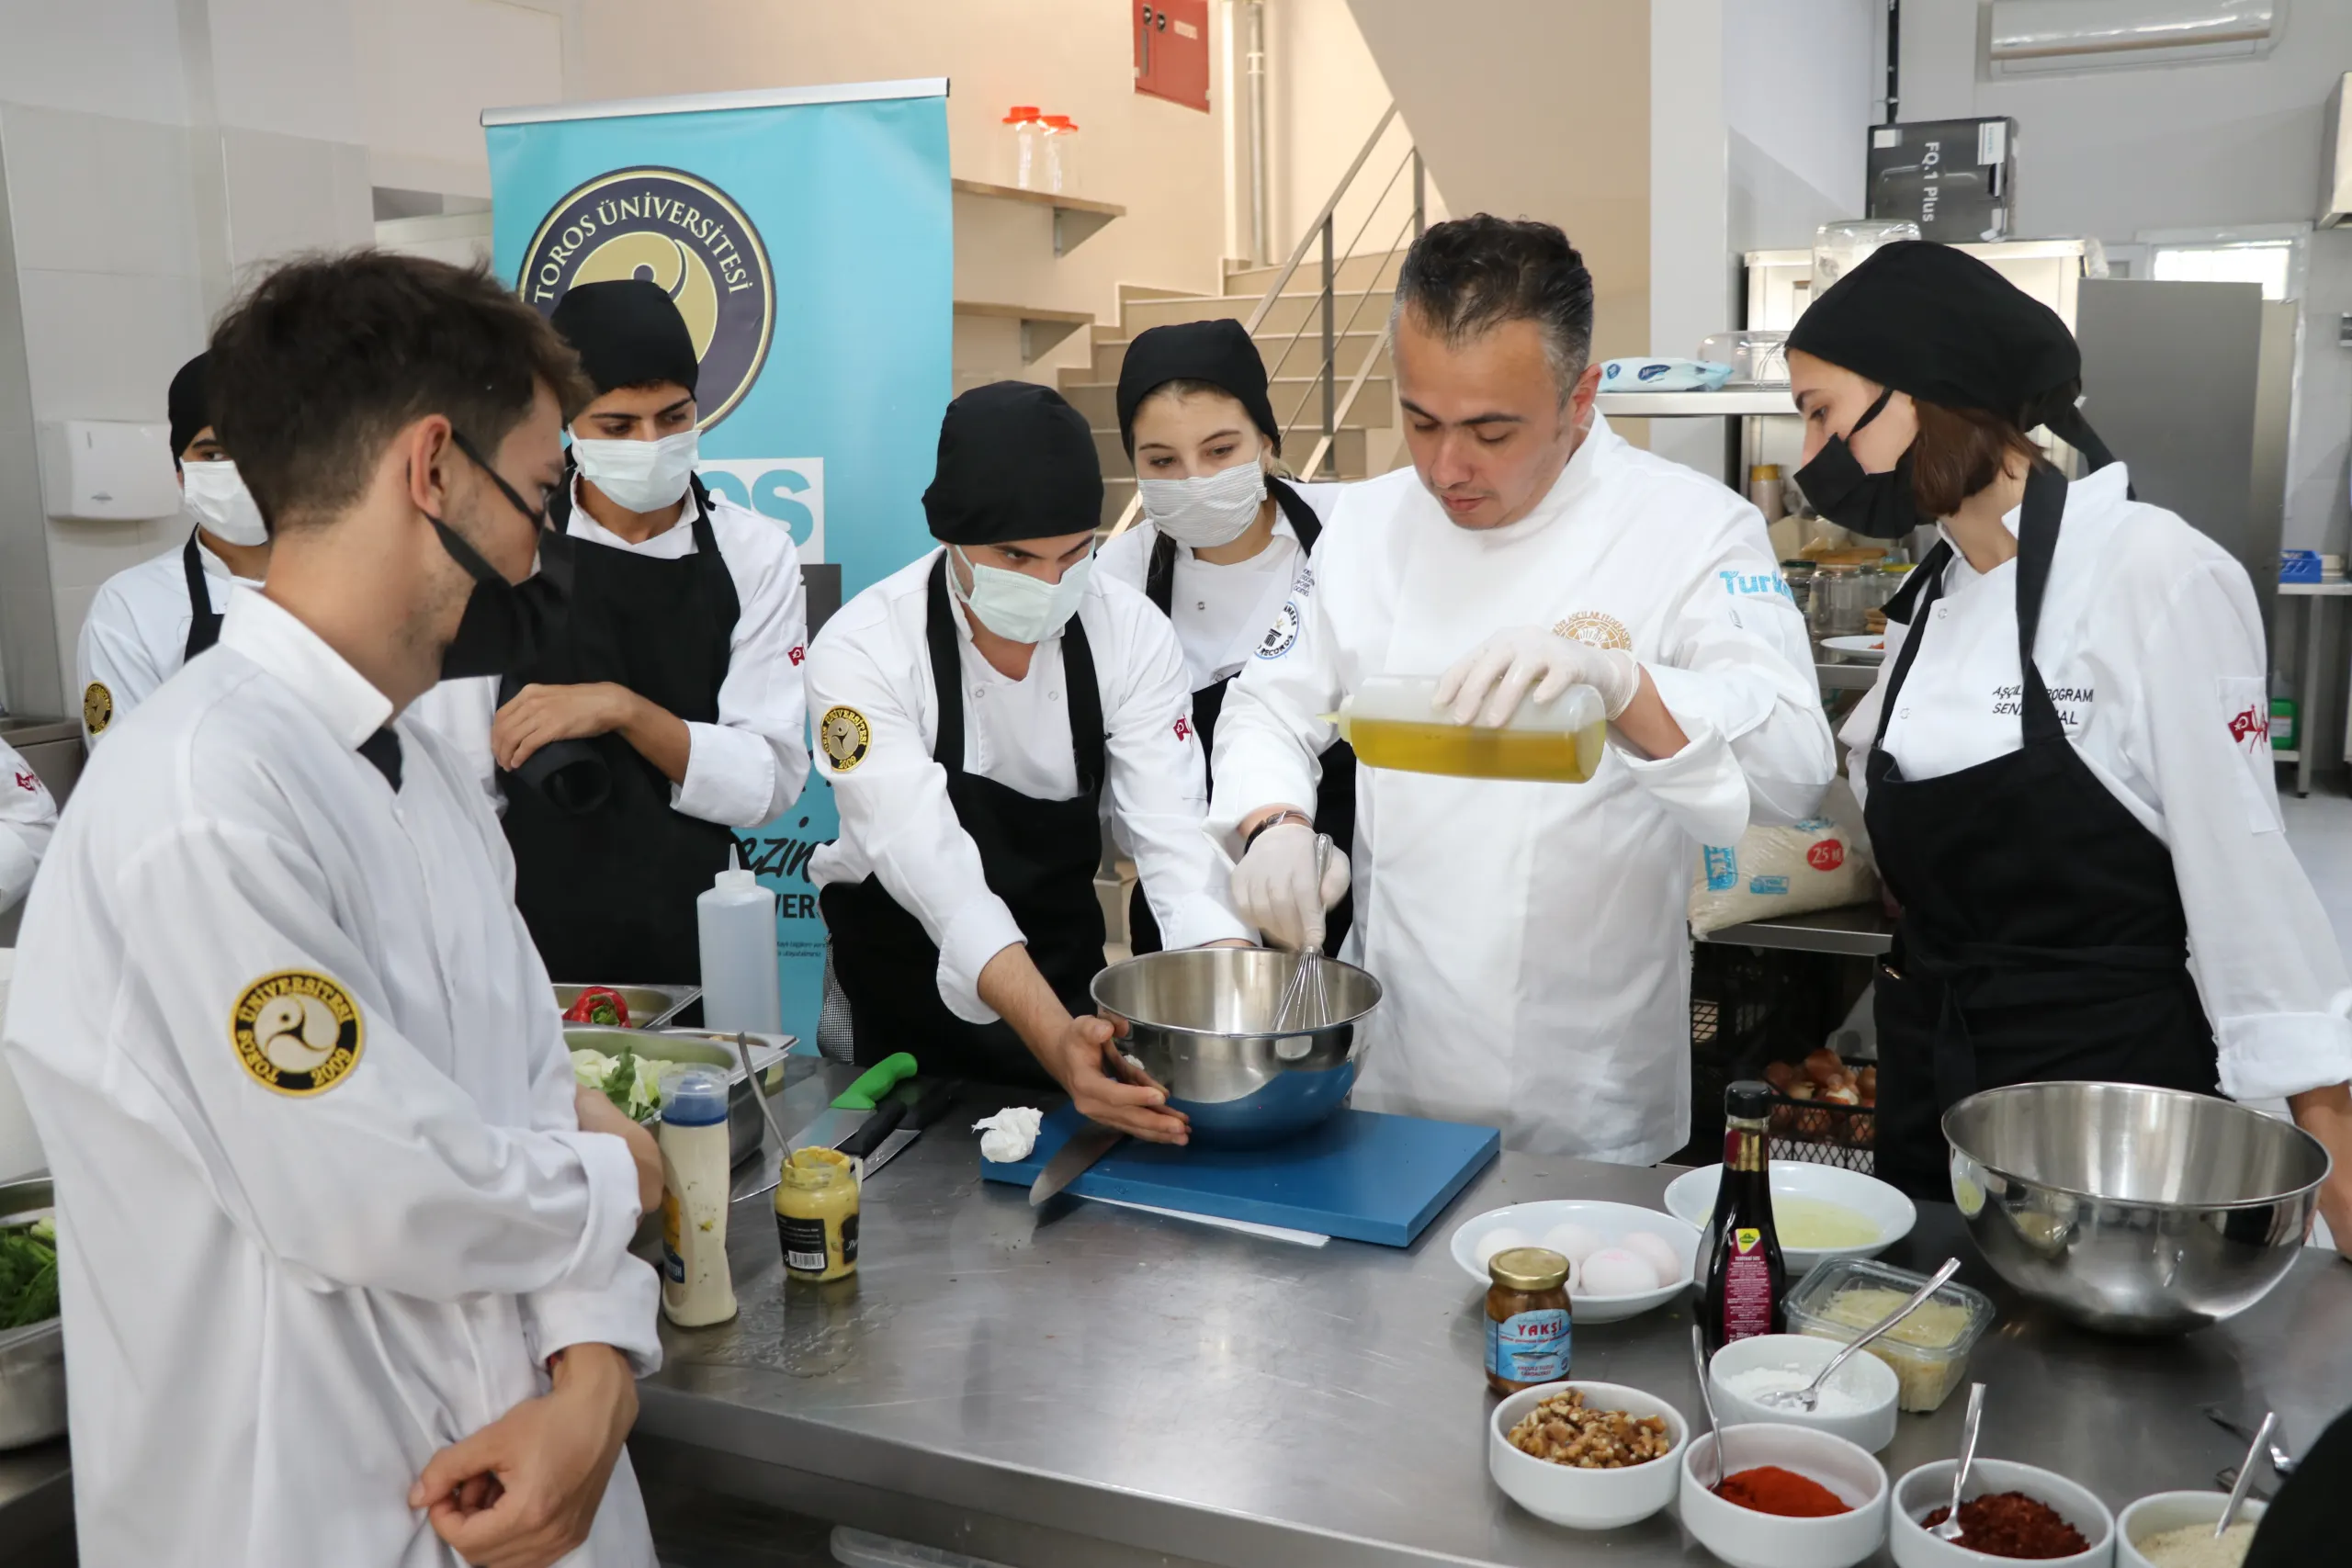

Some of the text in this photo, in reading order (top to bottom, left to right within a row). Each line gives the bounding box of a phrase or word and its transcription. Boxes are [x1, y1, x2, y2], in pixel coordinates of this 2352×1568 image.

[1922, 186, 1939, 222] Plus
[535, 192, 754, 304] TOROS ÜNİVERSİTESİ
[1260, 634, 1294, 657] RECORDS
[1812, 846, 1830, 864] 25
[237, 1029, 281, 1084] TOROS
[311, 1047, 354, 1089] 2009
